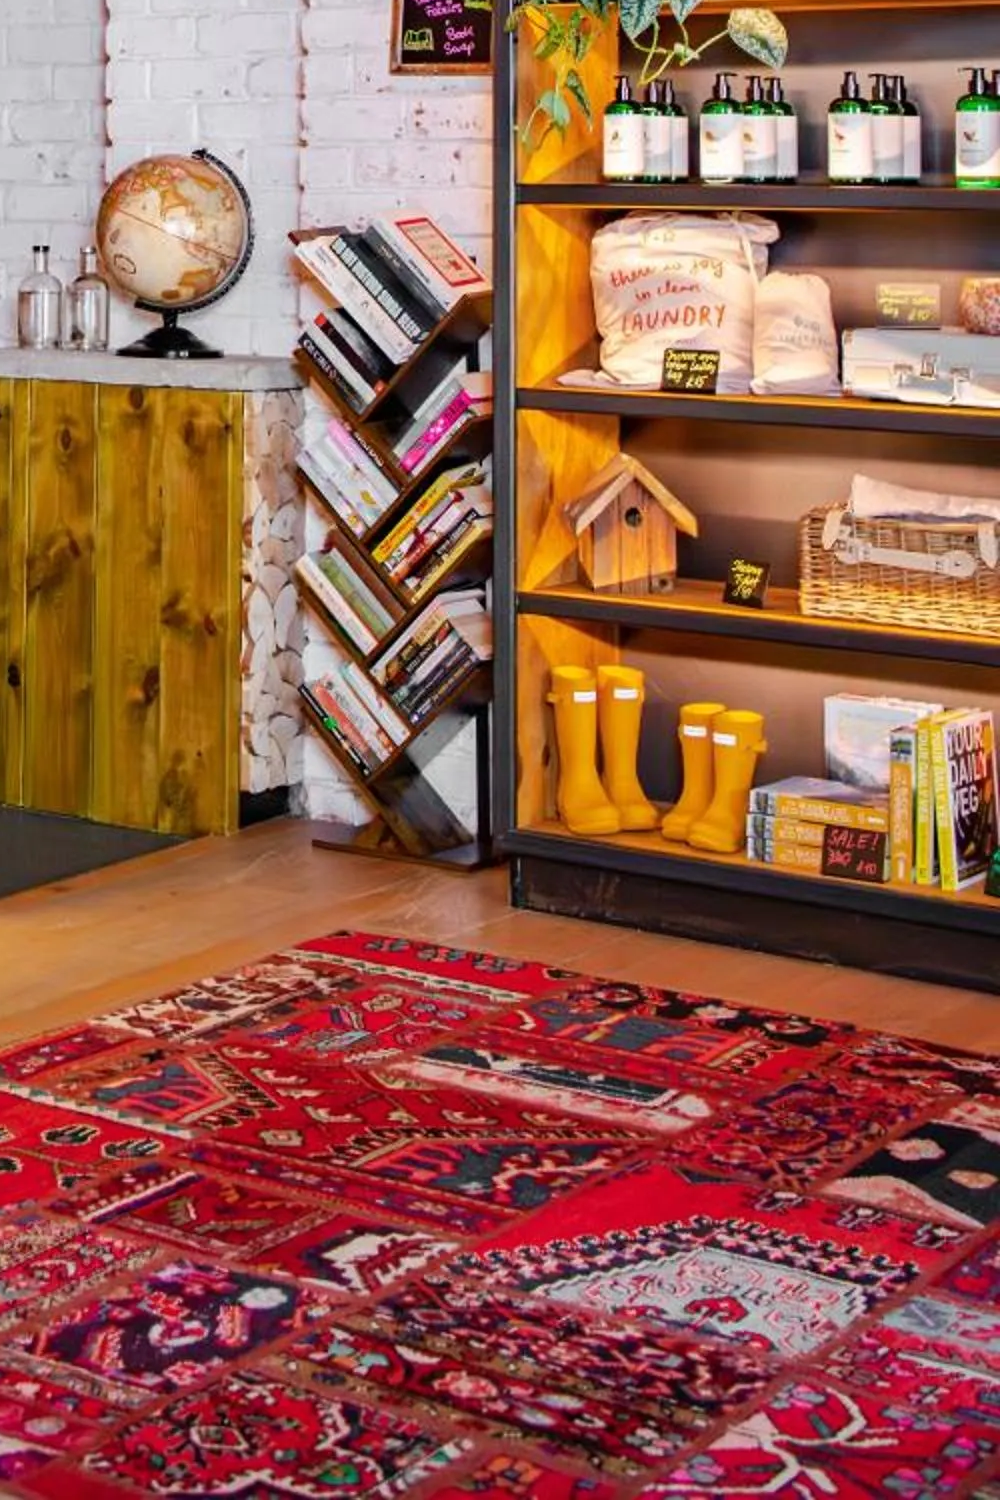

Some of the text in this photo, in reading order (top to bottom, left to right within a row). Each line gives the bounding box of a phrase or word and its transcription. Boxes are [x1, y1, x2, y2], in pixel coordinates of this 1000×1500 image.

[445, 25, 475, 41] Book
[443, 40, 476, 56] Swap
[657, 279, 701, 297] clean
[621, 303, 726, 338] LAUNDRY
[949, 750, 988, 789] DAILY
[827, 828, 880, 851] SALE!
